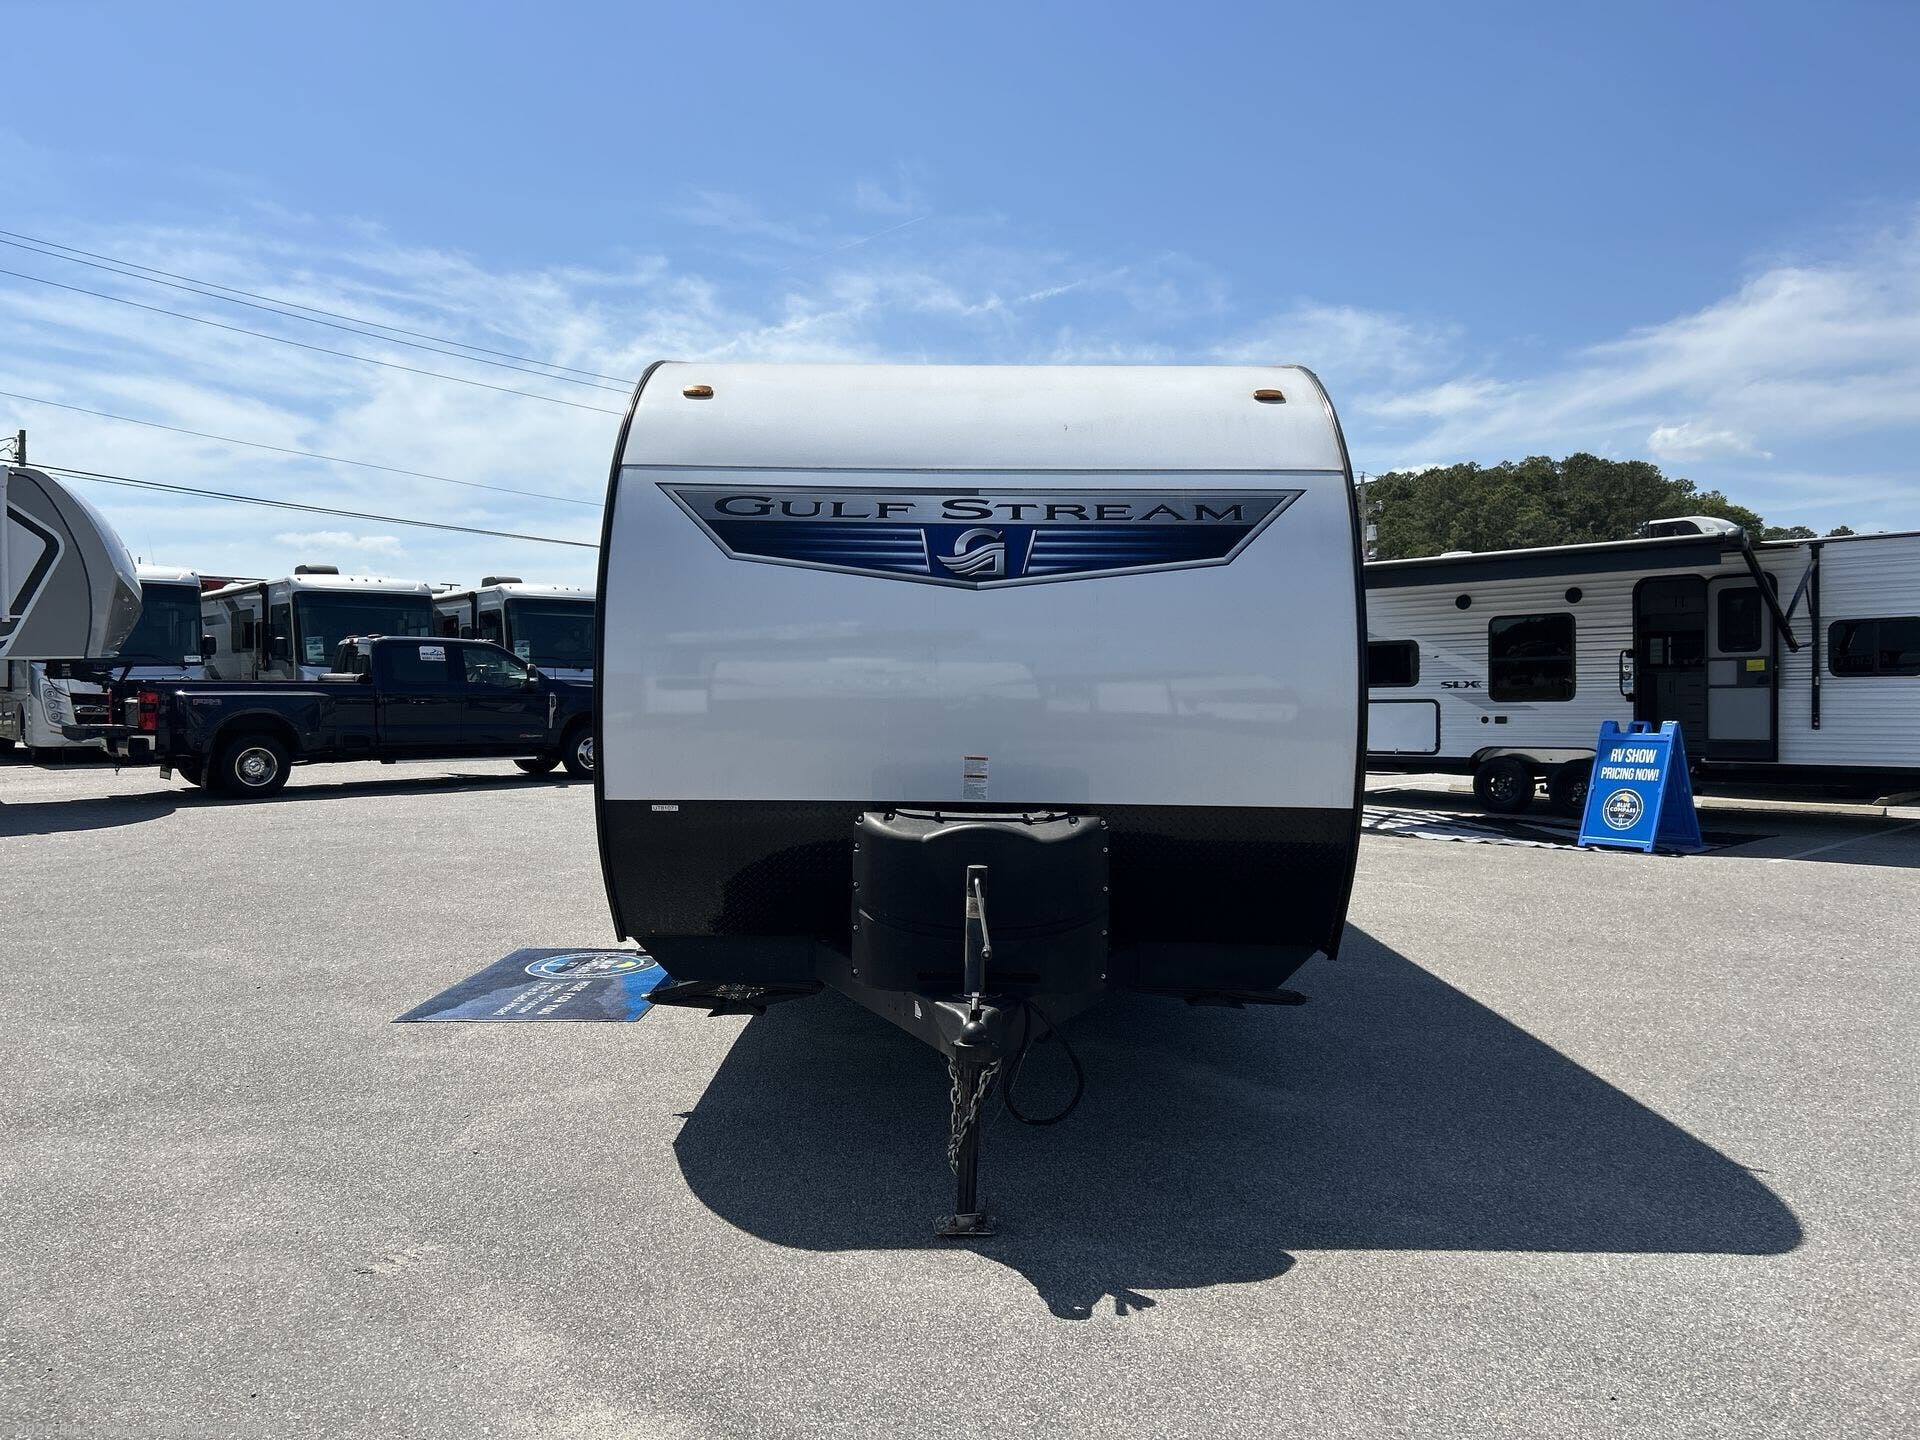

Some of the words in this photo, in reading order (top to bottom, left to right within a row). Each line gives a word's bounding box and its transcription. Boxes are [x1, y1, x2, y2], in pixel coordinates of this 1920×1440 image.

[714, 495, 917, 518] GULF
[941, 499, 1247, 521] STREAM
[1610, 748, 1626, 763] RV
[1625, 748, 1657, 764] SHOW
[1600, 766, 1635, 780] PRICING
[1635, 768, 1660, 781] NOW!
[551, 992, 577, 1002] FOR
